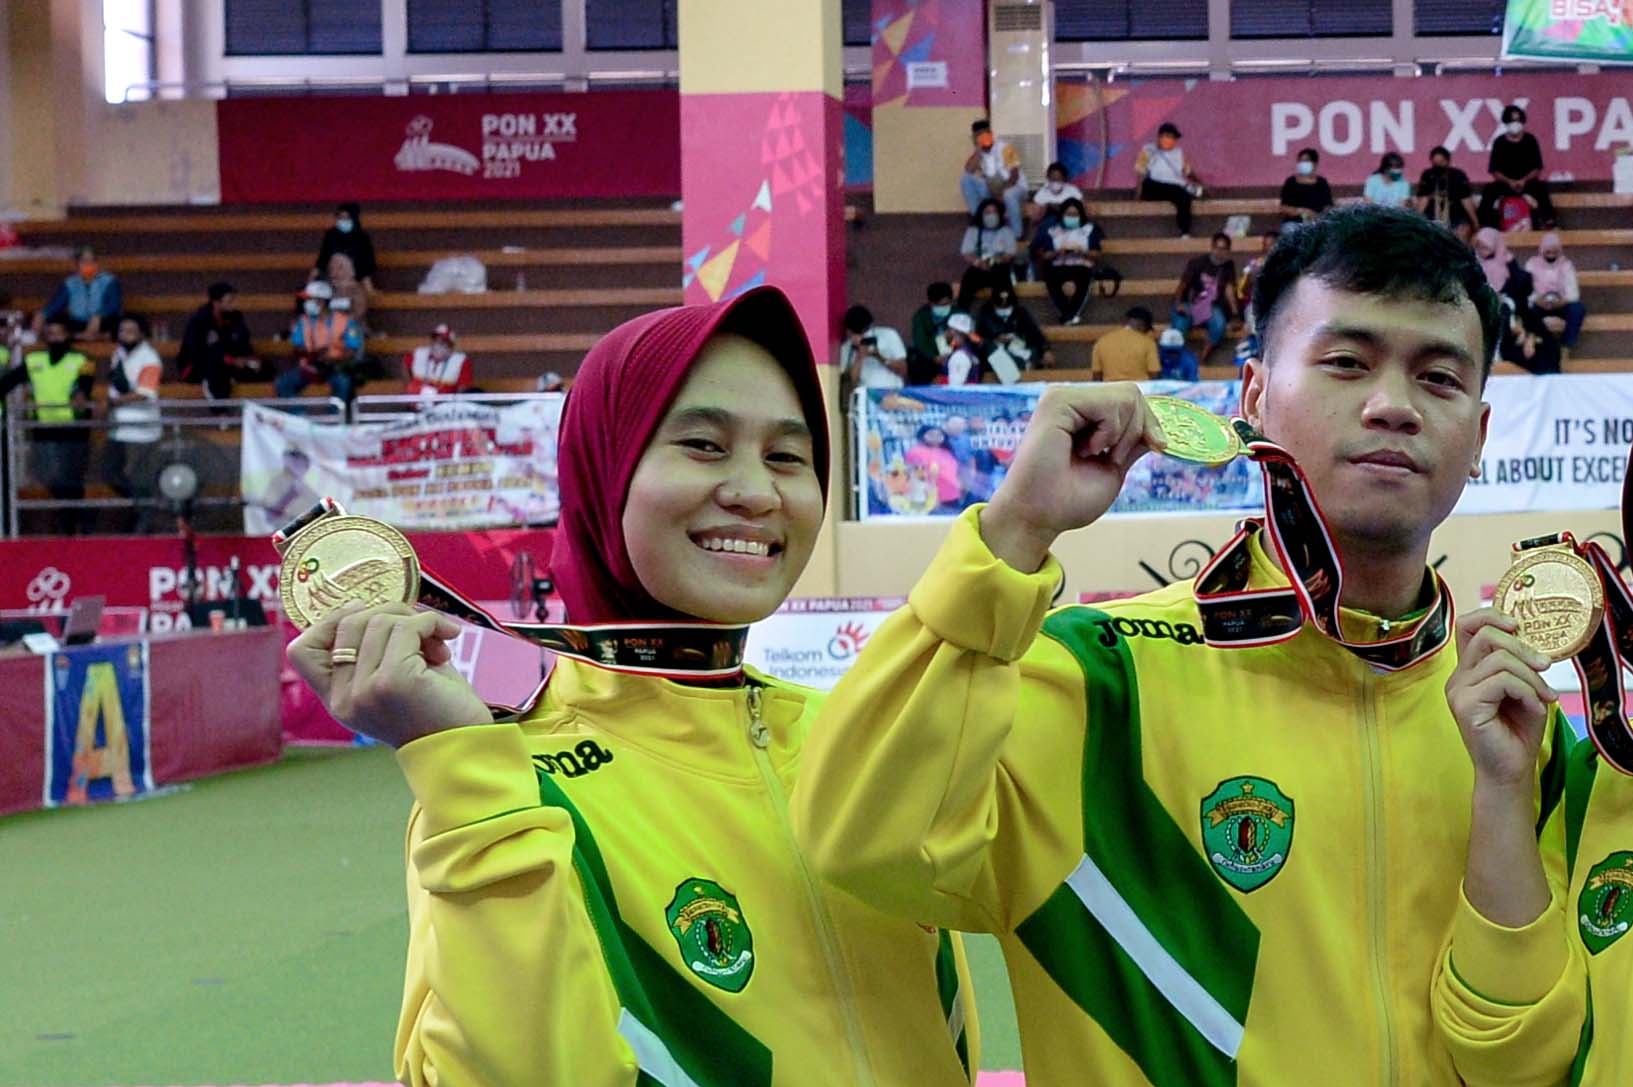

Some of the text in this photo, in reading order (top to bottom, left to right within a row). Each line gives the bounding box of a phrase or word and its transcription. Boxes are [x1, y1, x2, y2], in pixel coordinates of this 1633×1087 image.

[481, 112, 577, 136] PON XX
[1271, 99, 1415, 156] PON
[482, 142, 556, 161] PAPUA
[1555, 418, 1596, 445] IT'S
[1496, 456, 1564, 484] ABOUT
[246, 564, 281, 600] X
[764, 648, 823, 662] Telkom
[66, 663, 137, 805] A
